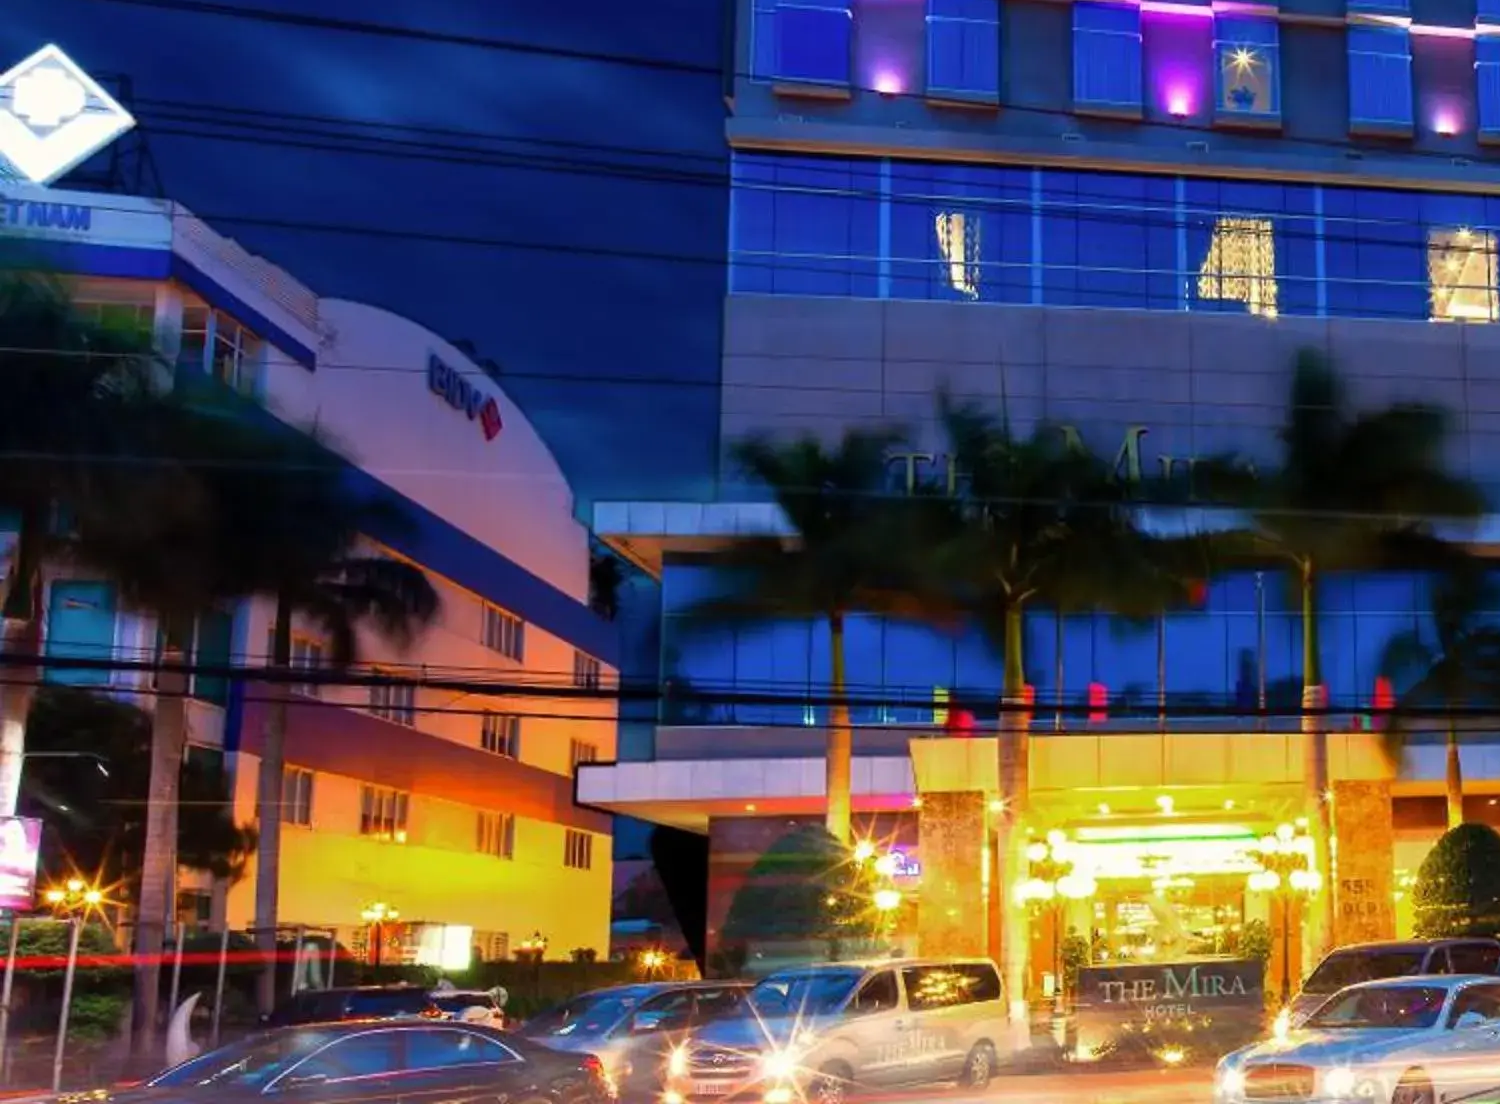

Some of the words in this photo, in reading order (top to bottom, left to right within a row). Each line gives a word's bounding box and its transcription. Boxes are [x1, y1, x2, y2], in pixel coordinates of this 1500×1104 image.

[27, 202, 91, 231] NAM
[1100, 979, 1157, 1004] THE
[1161, 965, 1248, 999] MIRA
[1144, 1002, 1198, 1018] HOTEL
